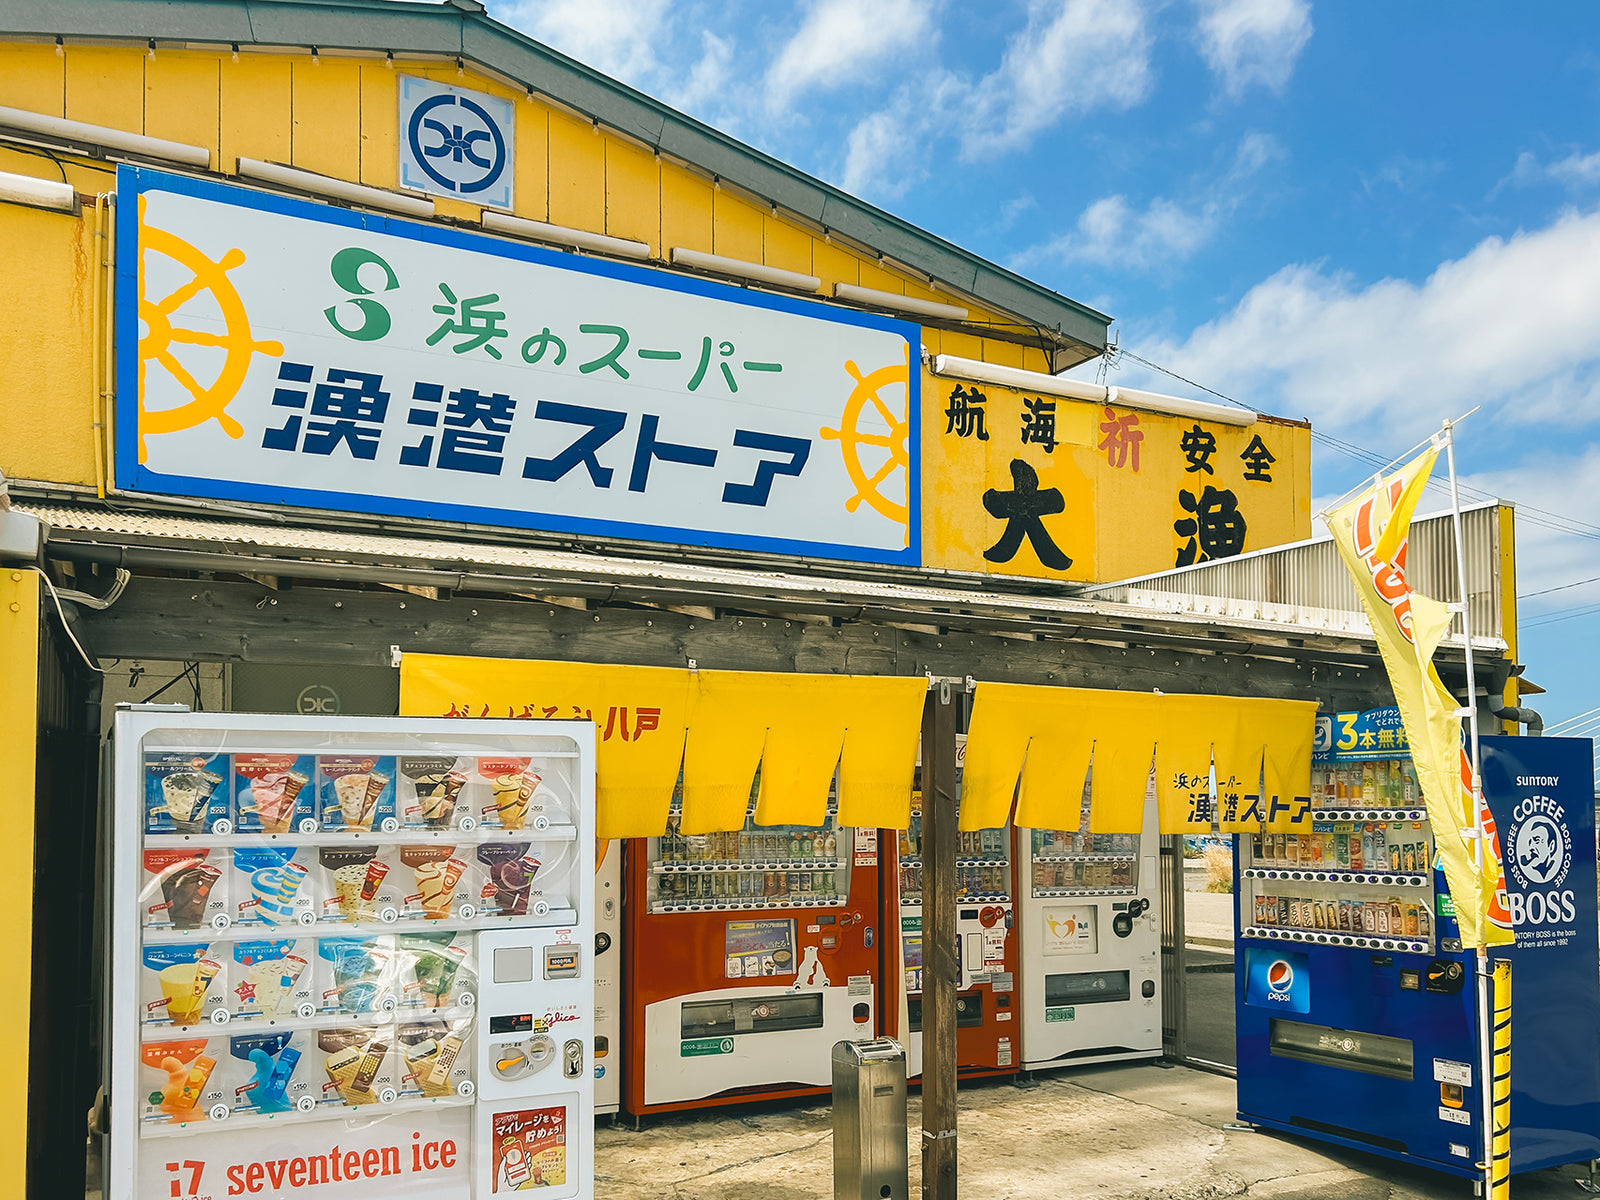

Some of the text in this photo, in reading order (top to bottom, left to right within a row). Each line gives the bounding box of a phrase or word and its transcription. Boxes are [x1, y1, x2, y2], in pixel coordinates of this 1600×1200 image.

[426, 281, 783, 394] 浜のスーパー
[262, 361, 812, 507] 漁港ストア
[945, 384, 1276, 483] 航海 祈 安全
[983, 458, 1247, 570] 大漁
[1173, 772, 1242, 790] 浜のスーパー
[1516, 775, 1559, 787] SUNTORY
[1188, 793, 1311, 823] 漁港ストア
[1513, 795, 1565, 823] COFFEE
[1507, 823, 1529, 889] BOSS COFFEE
[1554, 822, 1572, 888] BOSS COFFEE
[1508, 890, 1576, 926] BOSS
[1517, 941, 1523, 949] of
[1524, 940, 1536, 948] them
[1543, 939, 1556, 947] since
[1535, 930, 1551, 938] BOSS
[1564, 929, 1577, 937] boss
[1267, 991, 1291, 1003] pepsi
[496, 1113, 550, 1136] マイレージを
[525, 1125, 563, 1143] 貯めよう!
[227, 1132, 457, 1196] seventeen ice
